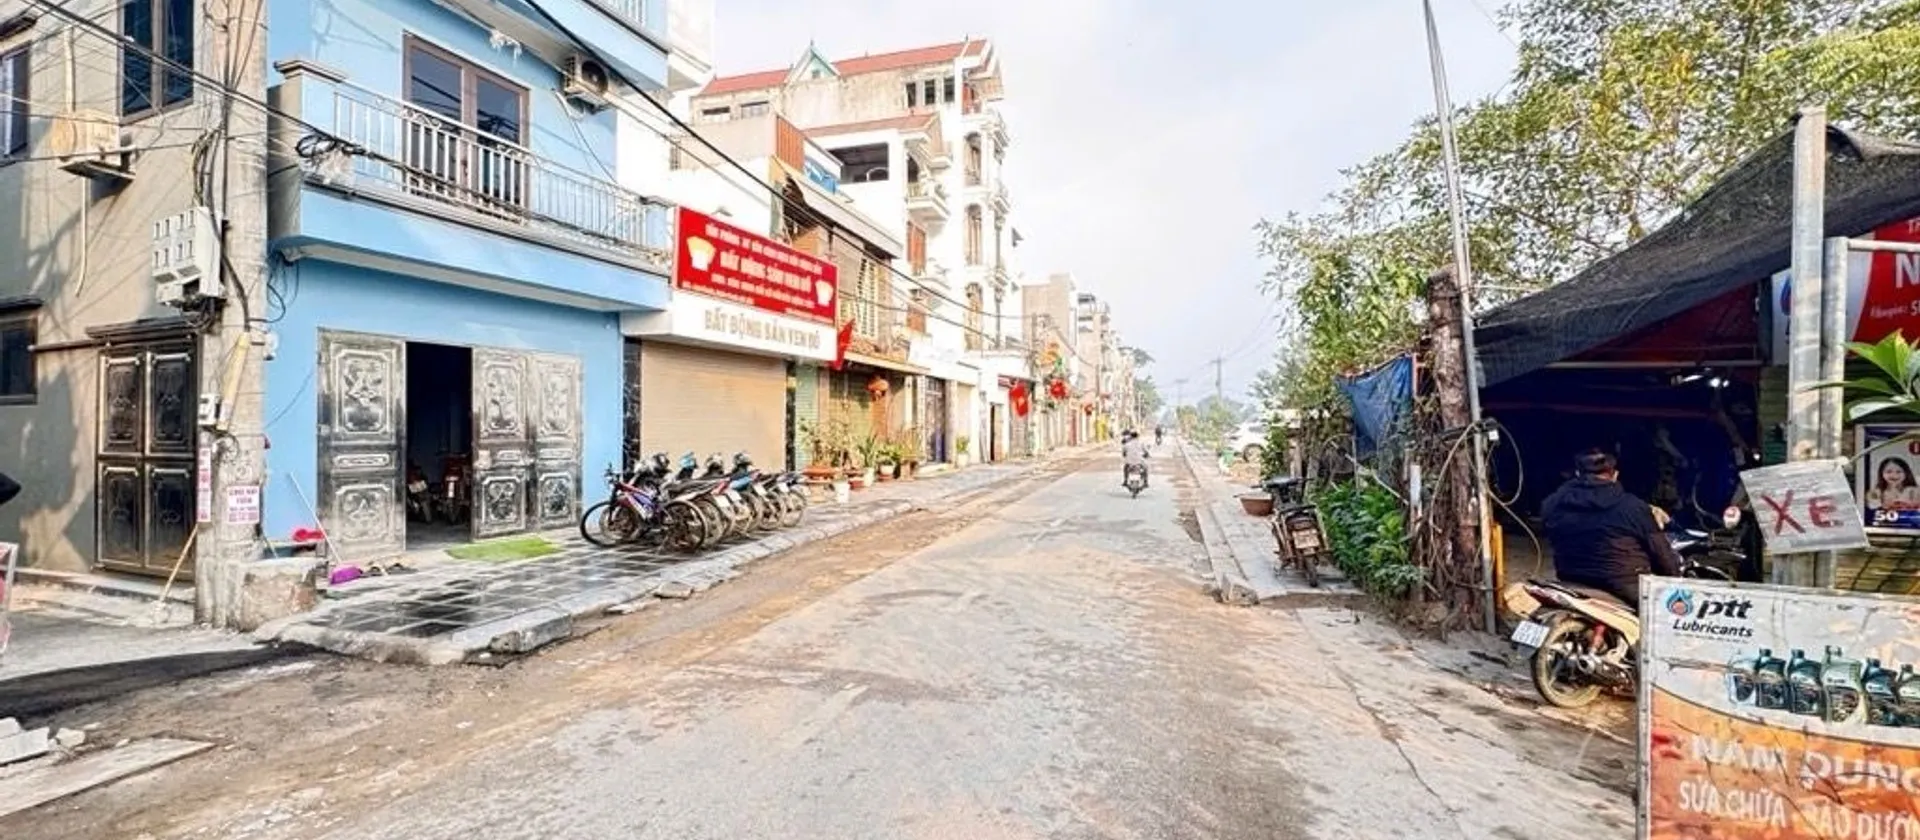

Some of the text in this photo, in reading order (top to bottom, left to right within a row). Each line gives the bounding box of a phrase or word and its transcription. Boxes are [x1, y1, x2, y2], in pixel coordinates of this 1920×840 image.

[1760, 489, 1845, 535] XE
[1874, 510, 1899, 522] 50
[1697, 600, 1753, 619] ptt
[1673, 619, 1754, 637] Lubricants
[1691, 735, 1788, 776] NAM
[1725, 787, 1787, 828] CHỮA
